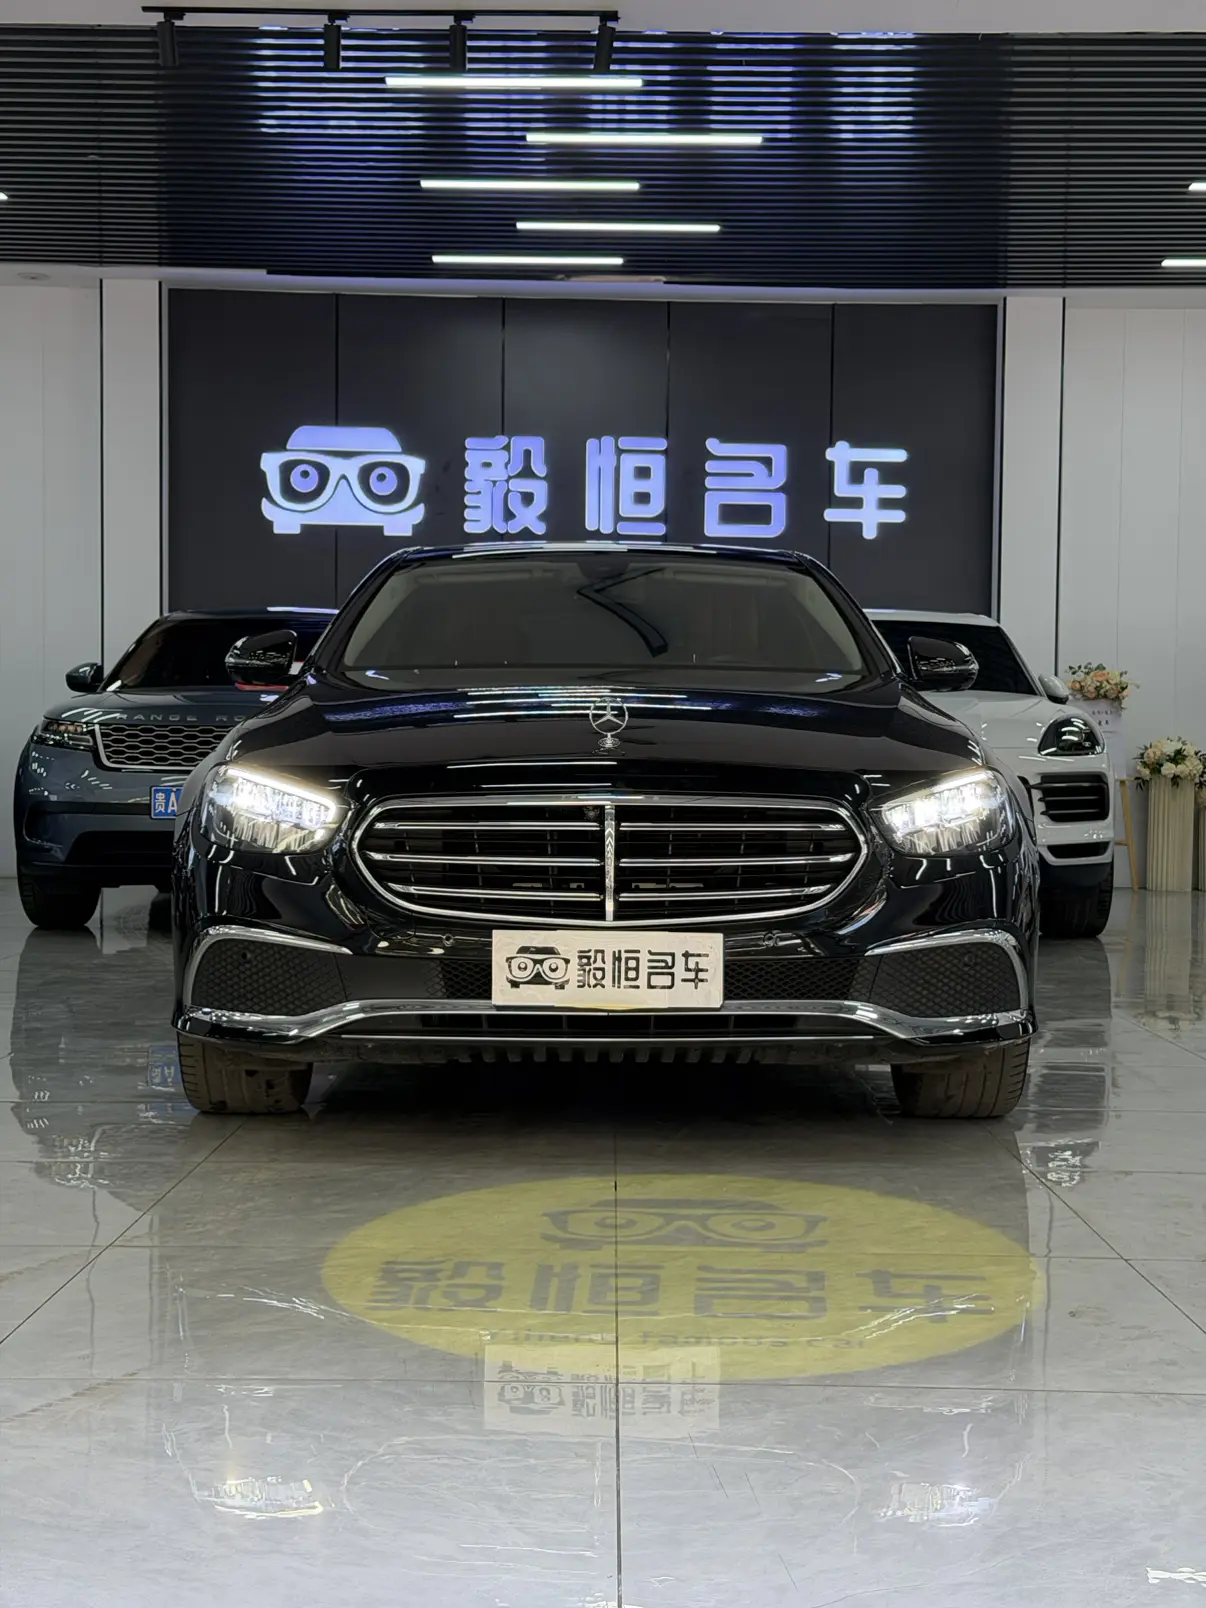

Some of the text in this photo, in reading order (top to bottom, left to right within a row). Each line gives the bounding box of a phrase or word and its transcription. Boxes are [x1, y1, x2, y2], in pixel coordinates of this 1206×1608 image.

[464, 436, 908, 540] 毅恒名车
[116, 713, 198, 721] RANGE
[155, 792, 177, 813] 贵A
[576, 949, 710, 990] 毅恒名车
[364, 1257, 995, 1324] 毅恒名车
